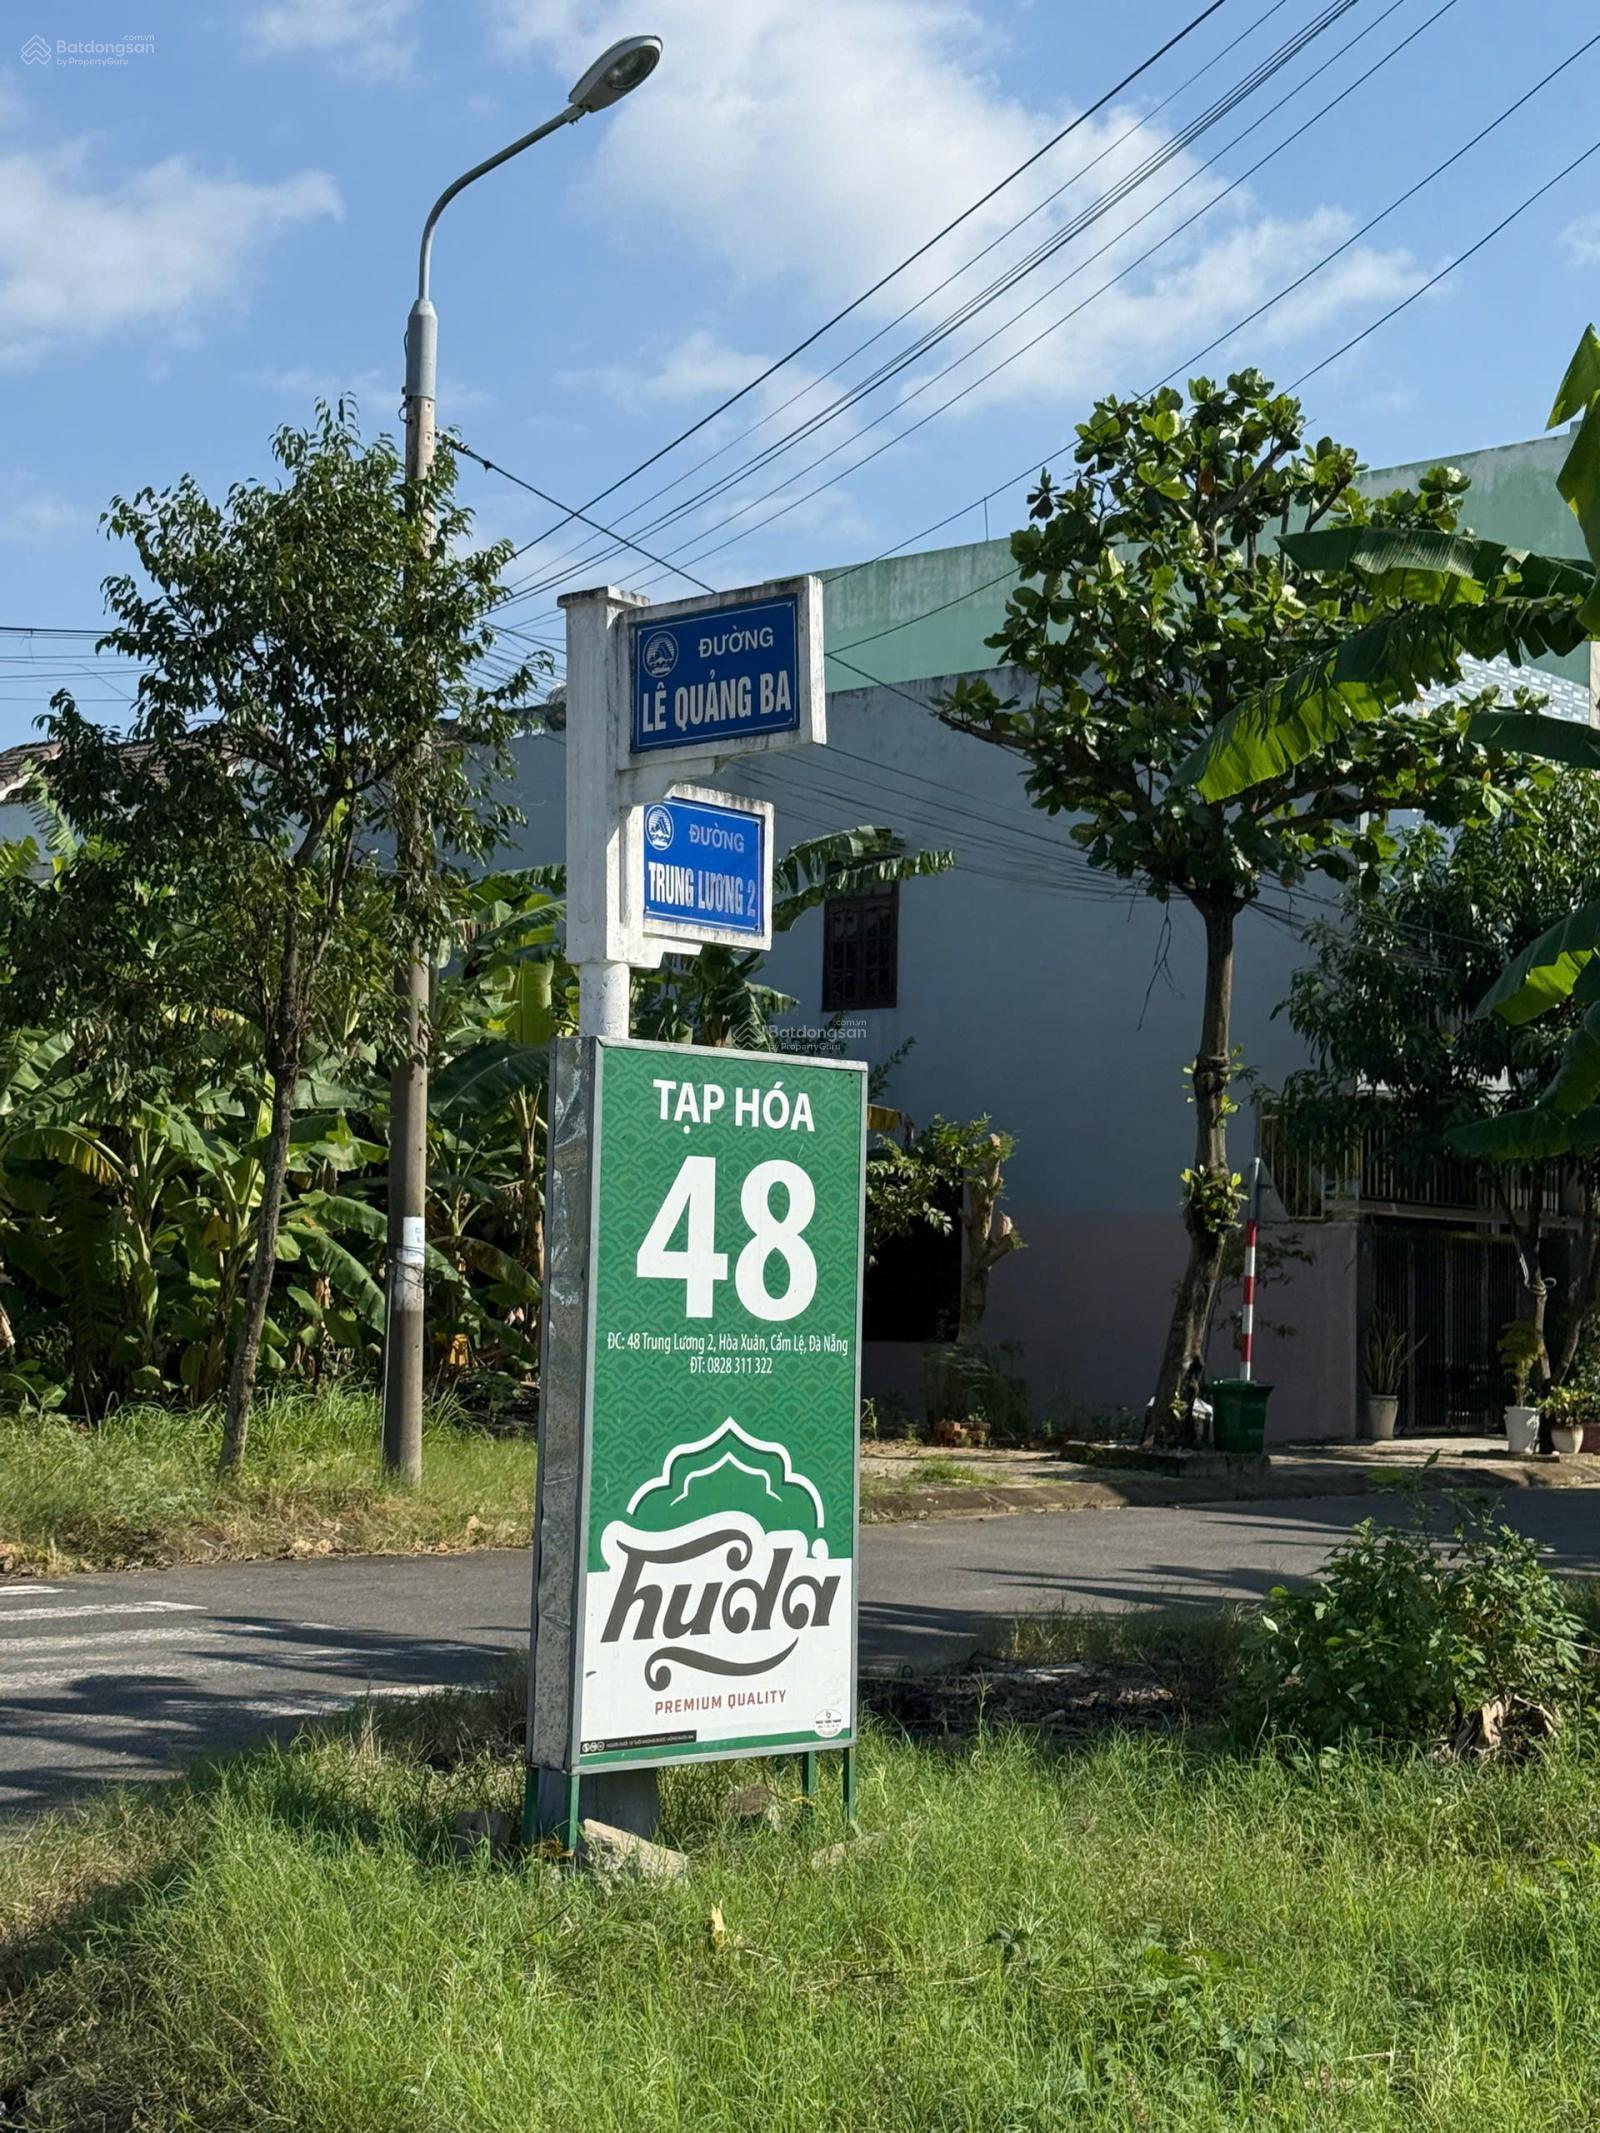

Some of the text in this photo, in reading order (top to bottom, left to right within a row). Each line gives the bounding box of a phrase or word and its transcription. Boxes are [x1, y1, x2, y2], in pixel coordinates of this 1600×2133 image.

[698, 624, 774, 658] ĐƯỜNG
[642, 669, 792, 733] LÊ QUẢNG BA
[688, 821, 745, 854] ĐƯỜNG
[648, 861, 756, 917] TRUNG LƯƠNG 2
[653, 1079, 815, 1134] TẠP HÓA
[636, 1155, 818, 1322] 48
[607, 1331, 848, 1356] ĐC: 48 Trung Lương 2, Hòa Xuân, Cẩm Lệ, Đà Nẵng
[690, 1356, 773, 1374] ĐT: 0828 311 322
[600, 1529, 841, 1643] huda
[655, 1689, 787, 1715] PREMIUM QUALITY
